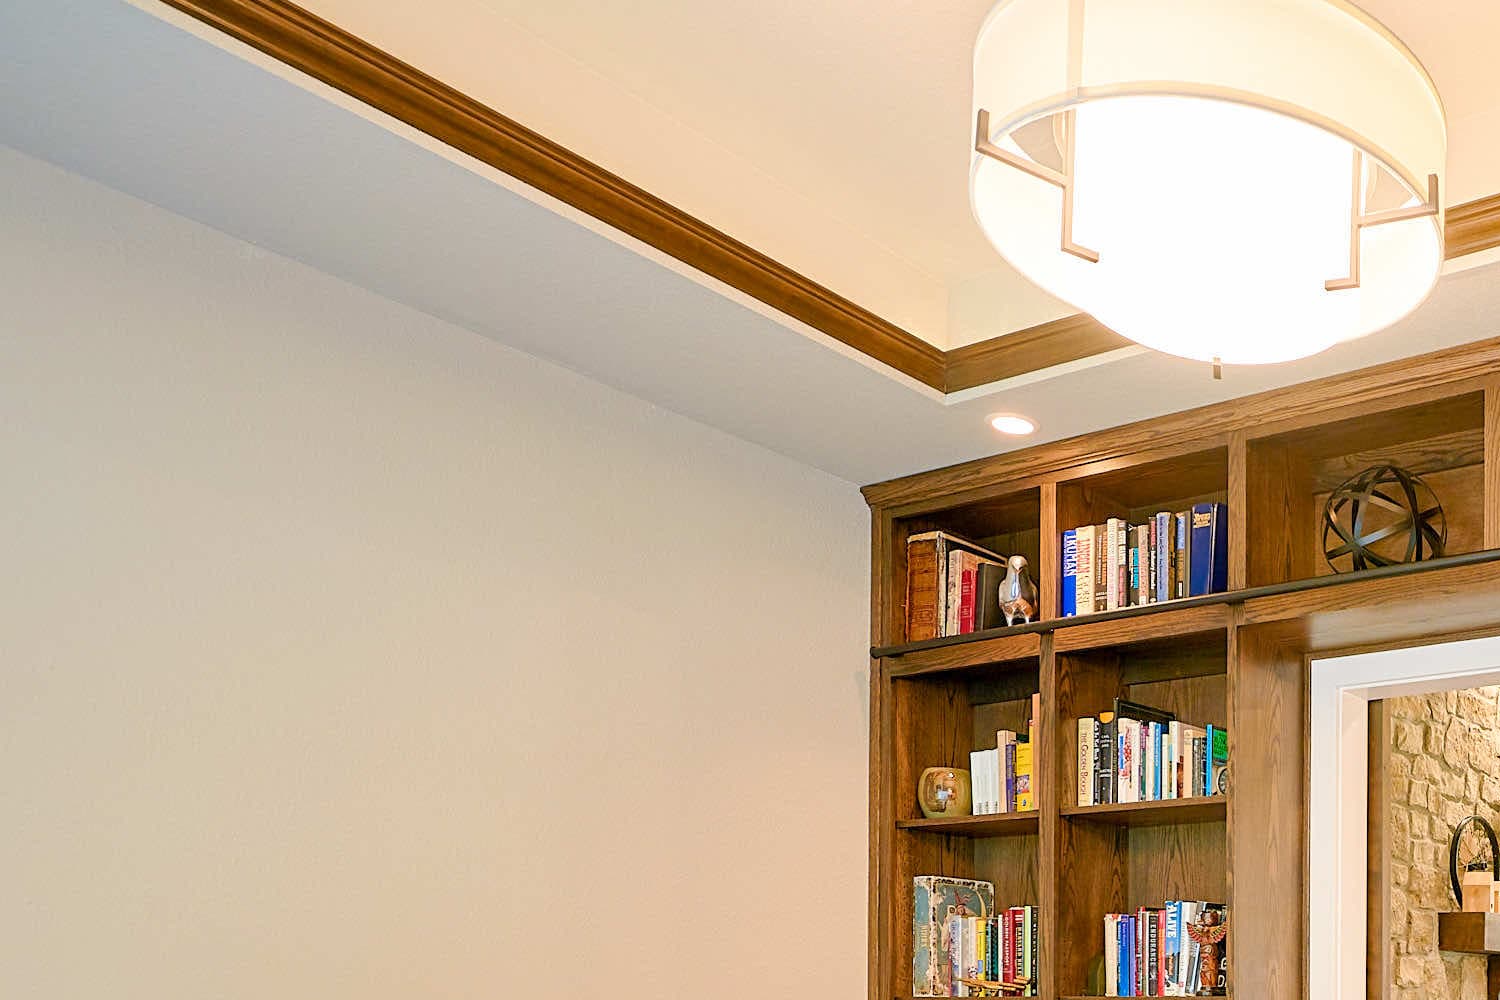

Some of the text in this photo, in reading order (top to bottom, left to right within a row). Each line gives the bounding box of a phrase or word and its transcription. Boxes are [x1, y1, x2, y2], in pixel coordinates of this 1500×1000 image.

[1066, 534, 1077, 577] TRUMAN
[1080, 745, 1089, 795] GOLDEN BOUGH
[1167, 904, 1177, 938] ALIVE
